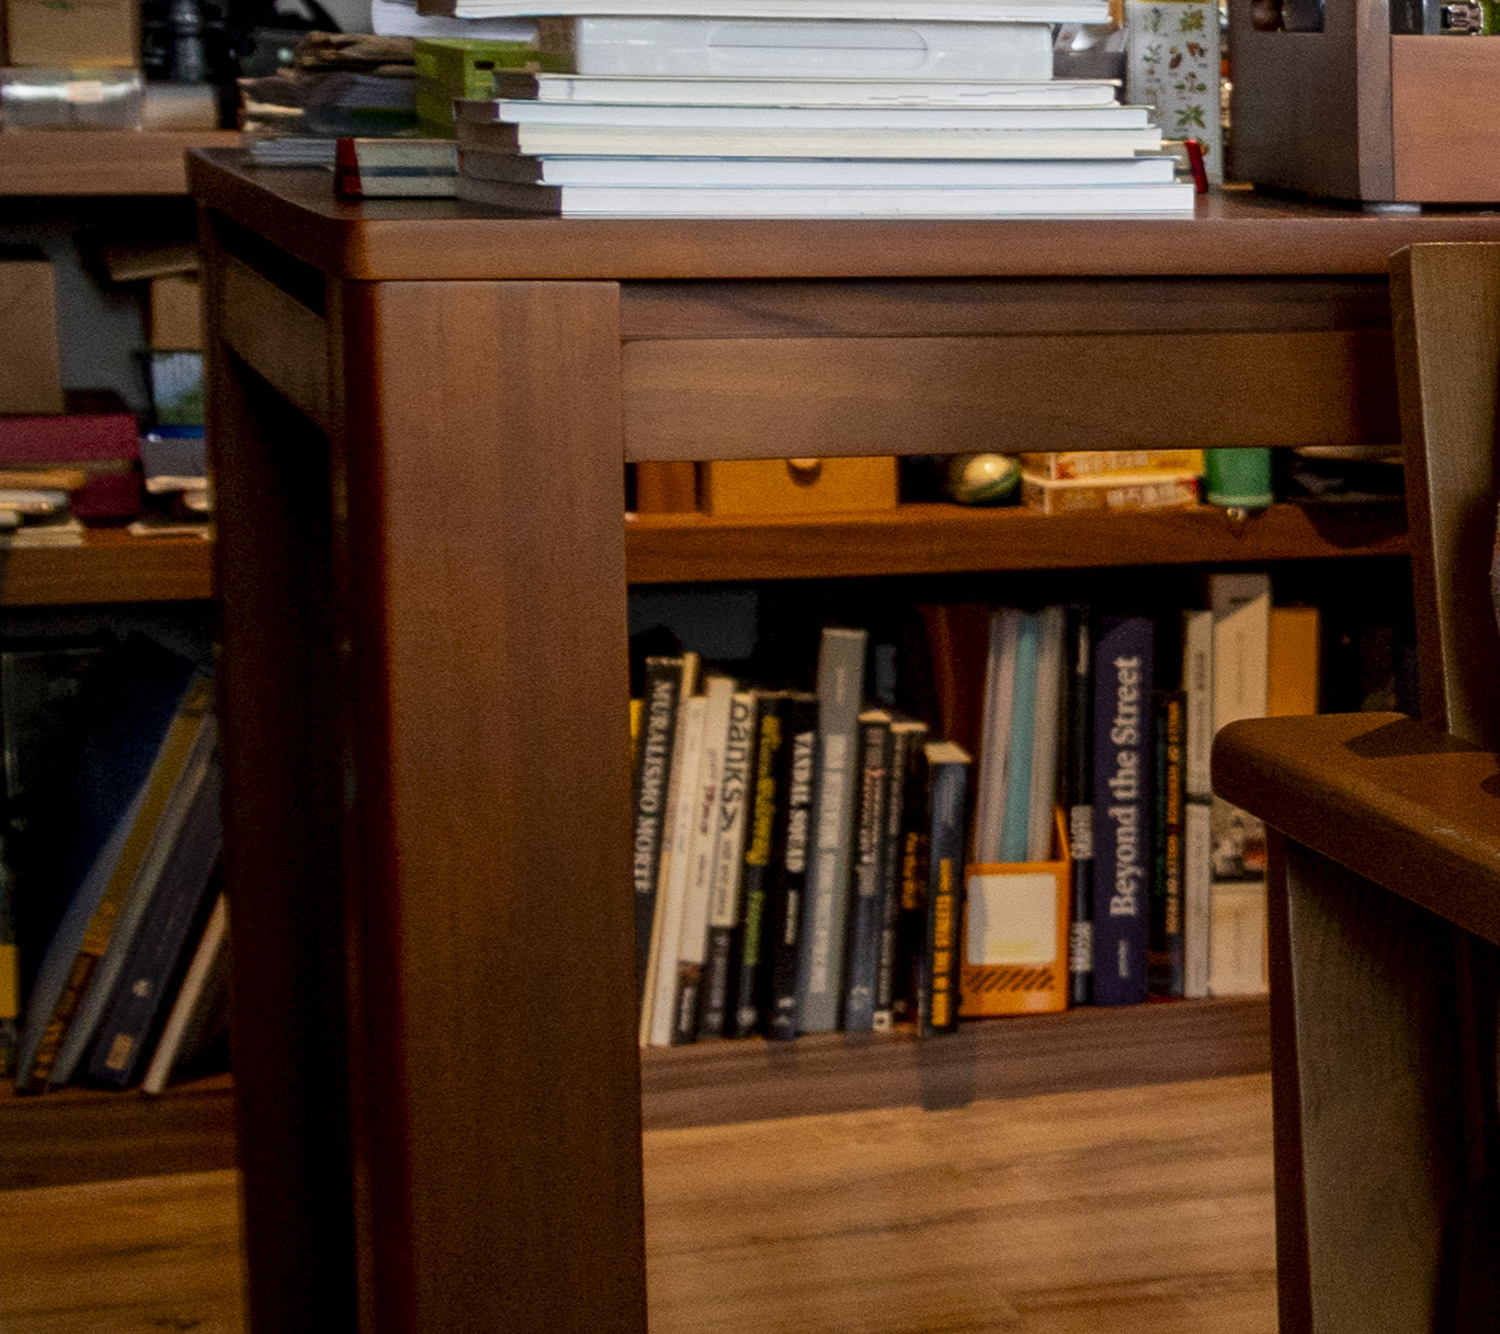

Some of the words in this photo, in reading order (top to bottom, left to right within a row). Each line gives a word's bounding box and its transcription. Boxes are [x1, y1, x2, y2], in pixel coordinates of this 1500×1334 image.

[1109, 657, 1141, 746] Street
[639, 680, 673, 814] MURALISMO
[788, 732, 814, 806] VANDAL
[1110, 751, 1138, 800] the
[785, 809, 809, 873] SQUAD
[1109, 805, 1144, 916] Beyond
